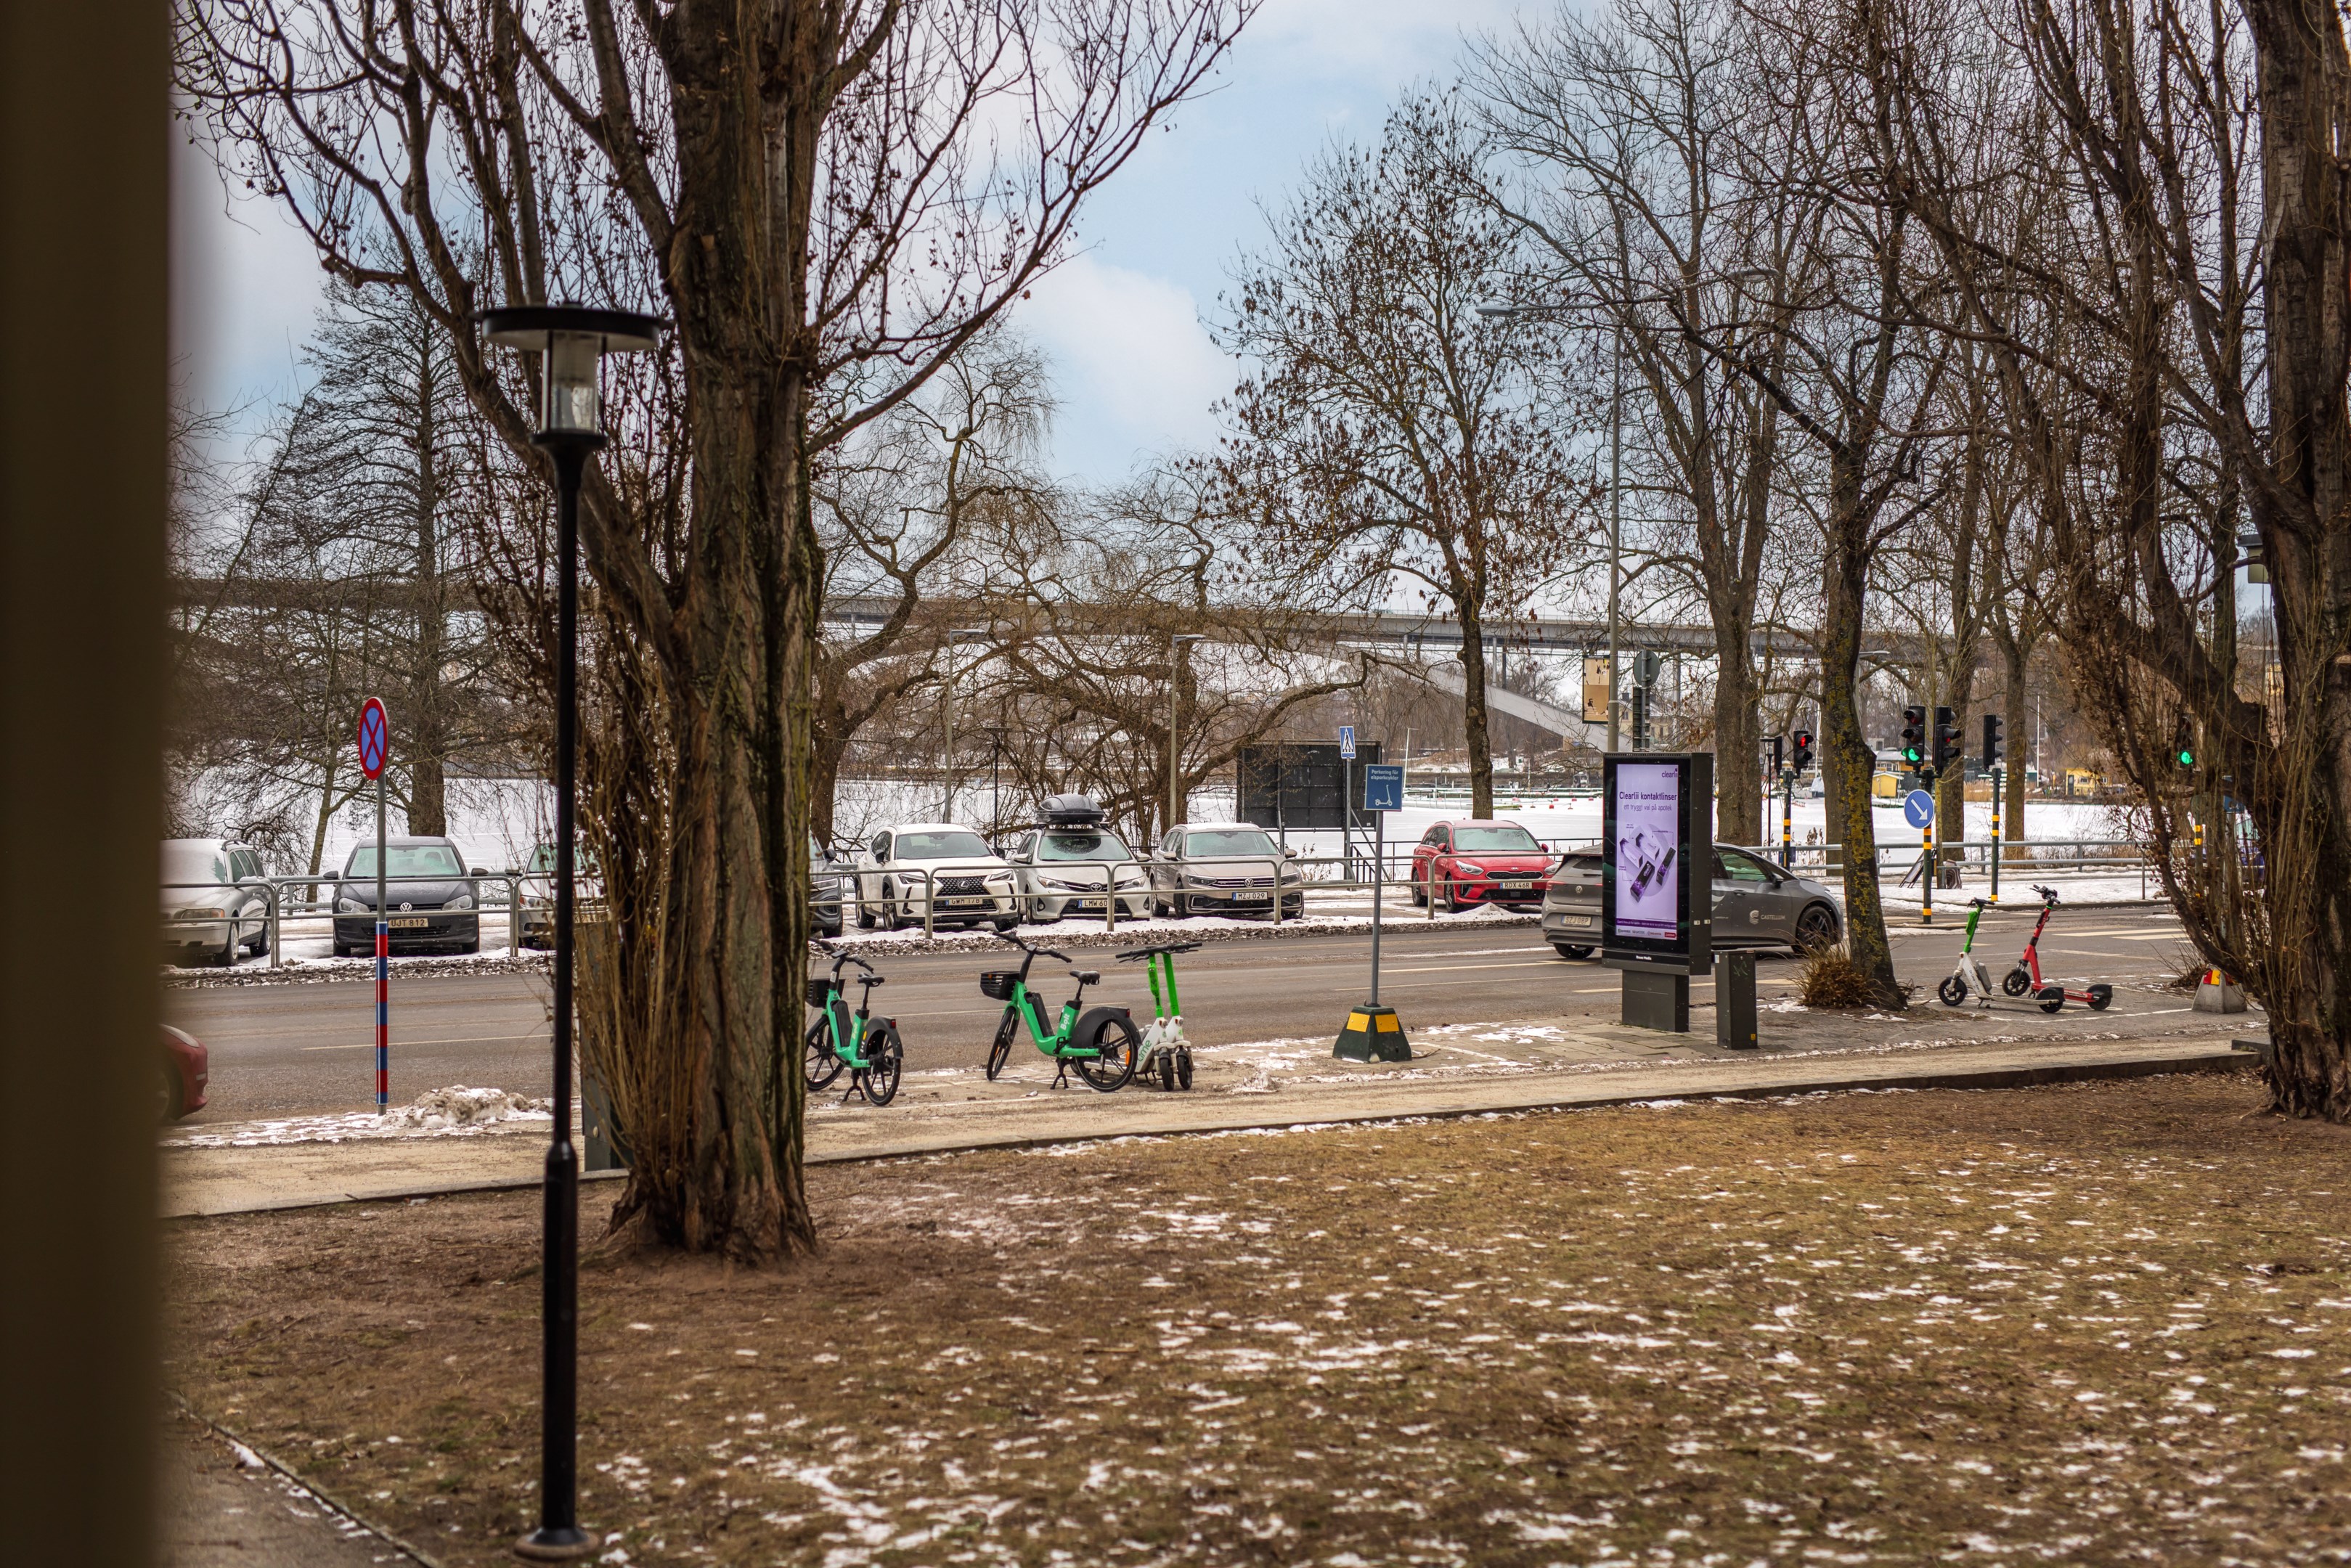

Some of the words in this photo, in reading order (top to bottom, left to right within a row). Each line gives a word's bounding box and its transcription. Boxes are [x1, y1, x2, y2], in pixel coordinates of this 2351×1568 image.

[1619, 791, 1639, 800] Clearlii
[1640, 792, 1677, 801] kontaktlinser
[1060, 1013, 1070, 1031] Bolt
